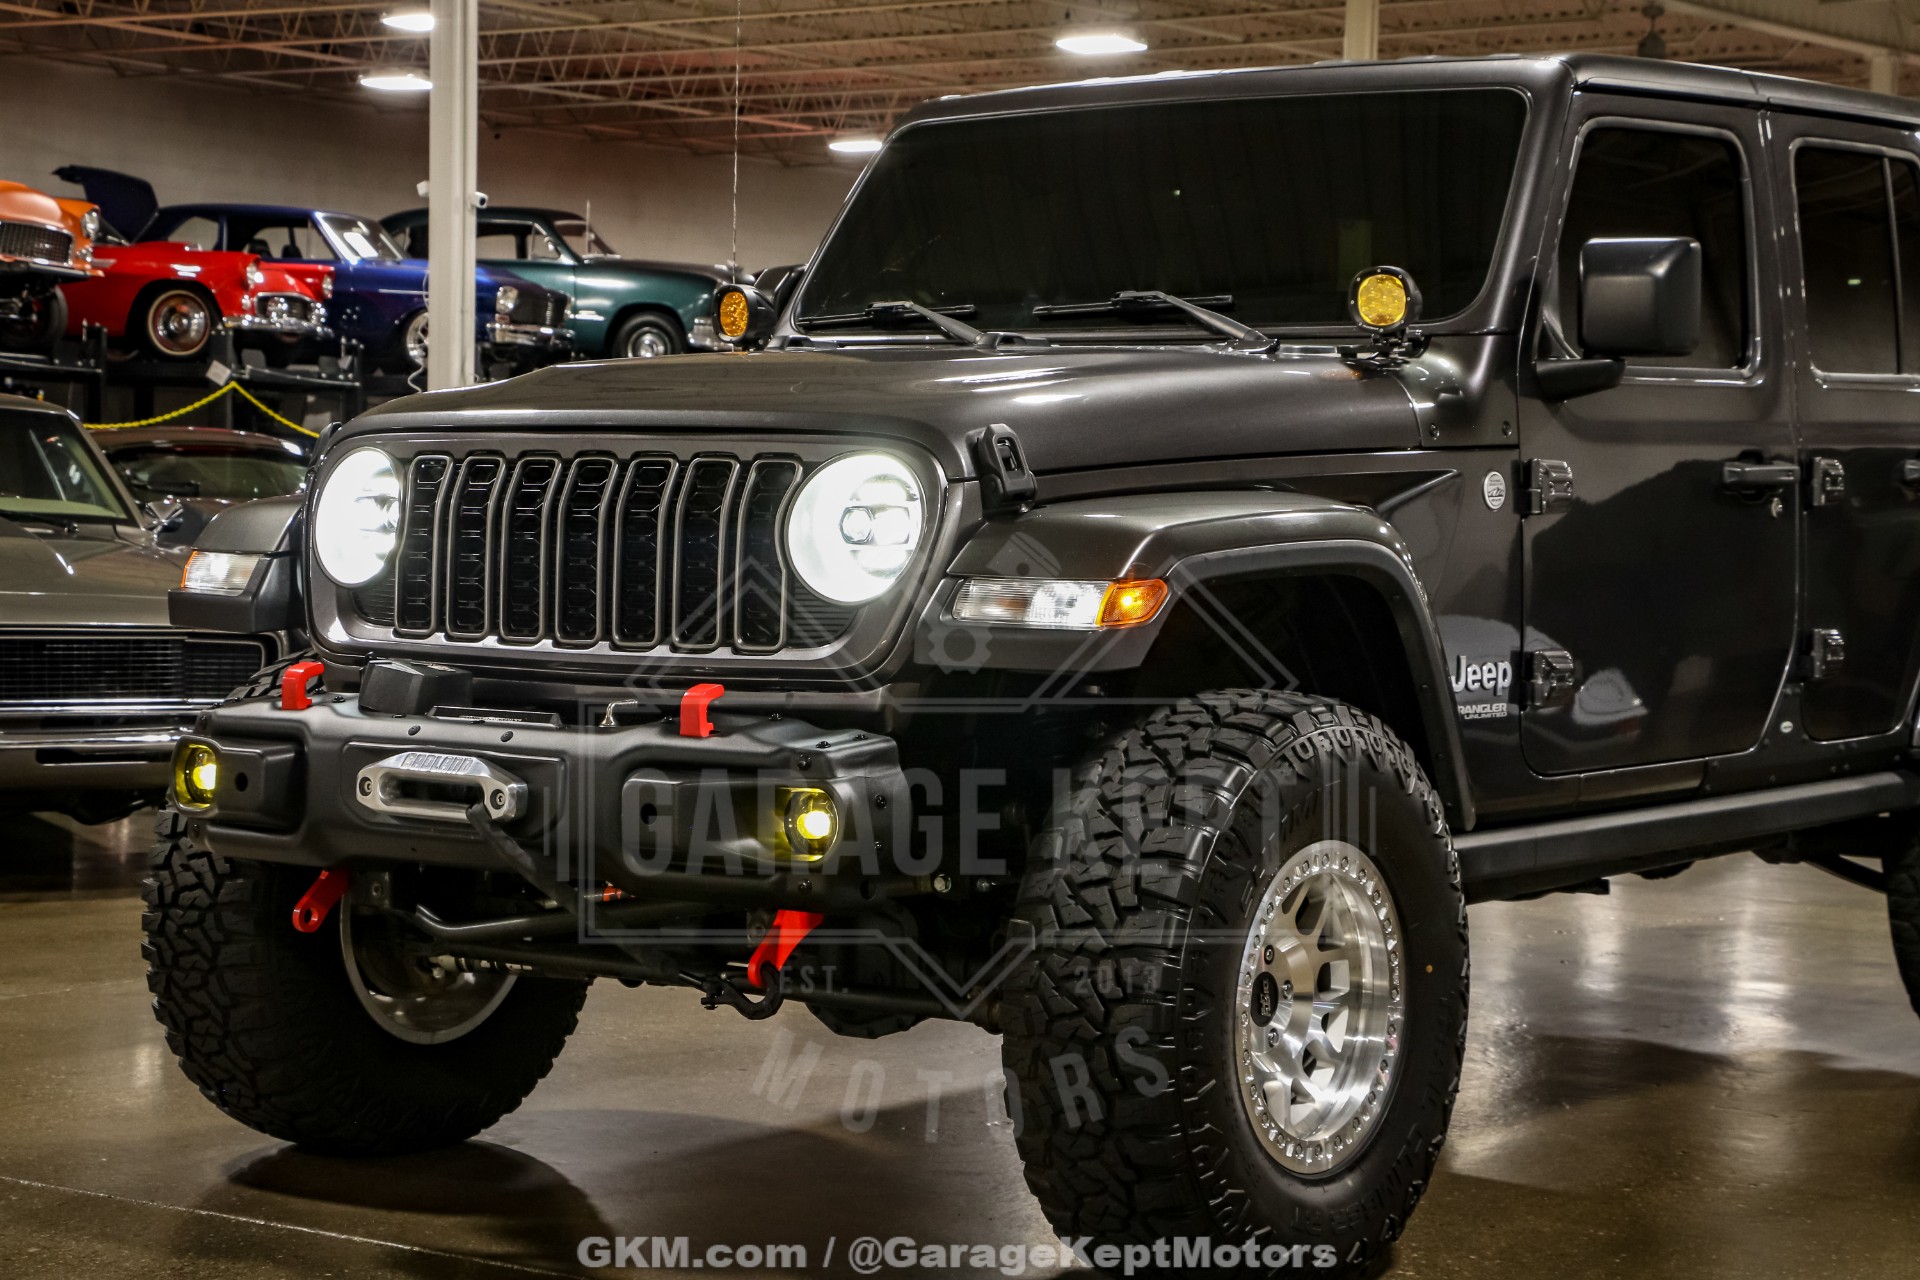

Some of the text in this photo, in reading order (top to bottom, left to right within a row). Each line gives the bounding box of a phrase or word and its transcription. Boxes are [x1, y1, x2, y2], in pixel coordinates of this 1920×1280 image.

[1451, 655, 1512, 695] Jeep
[1458, 703, 1507, 714] RANGLER
[1464, 711, 1508, 720] UNLIMITED
[401, 752, 474, 775] BADLAND
